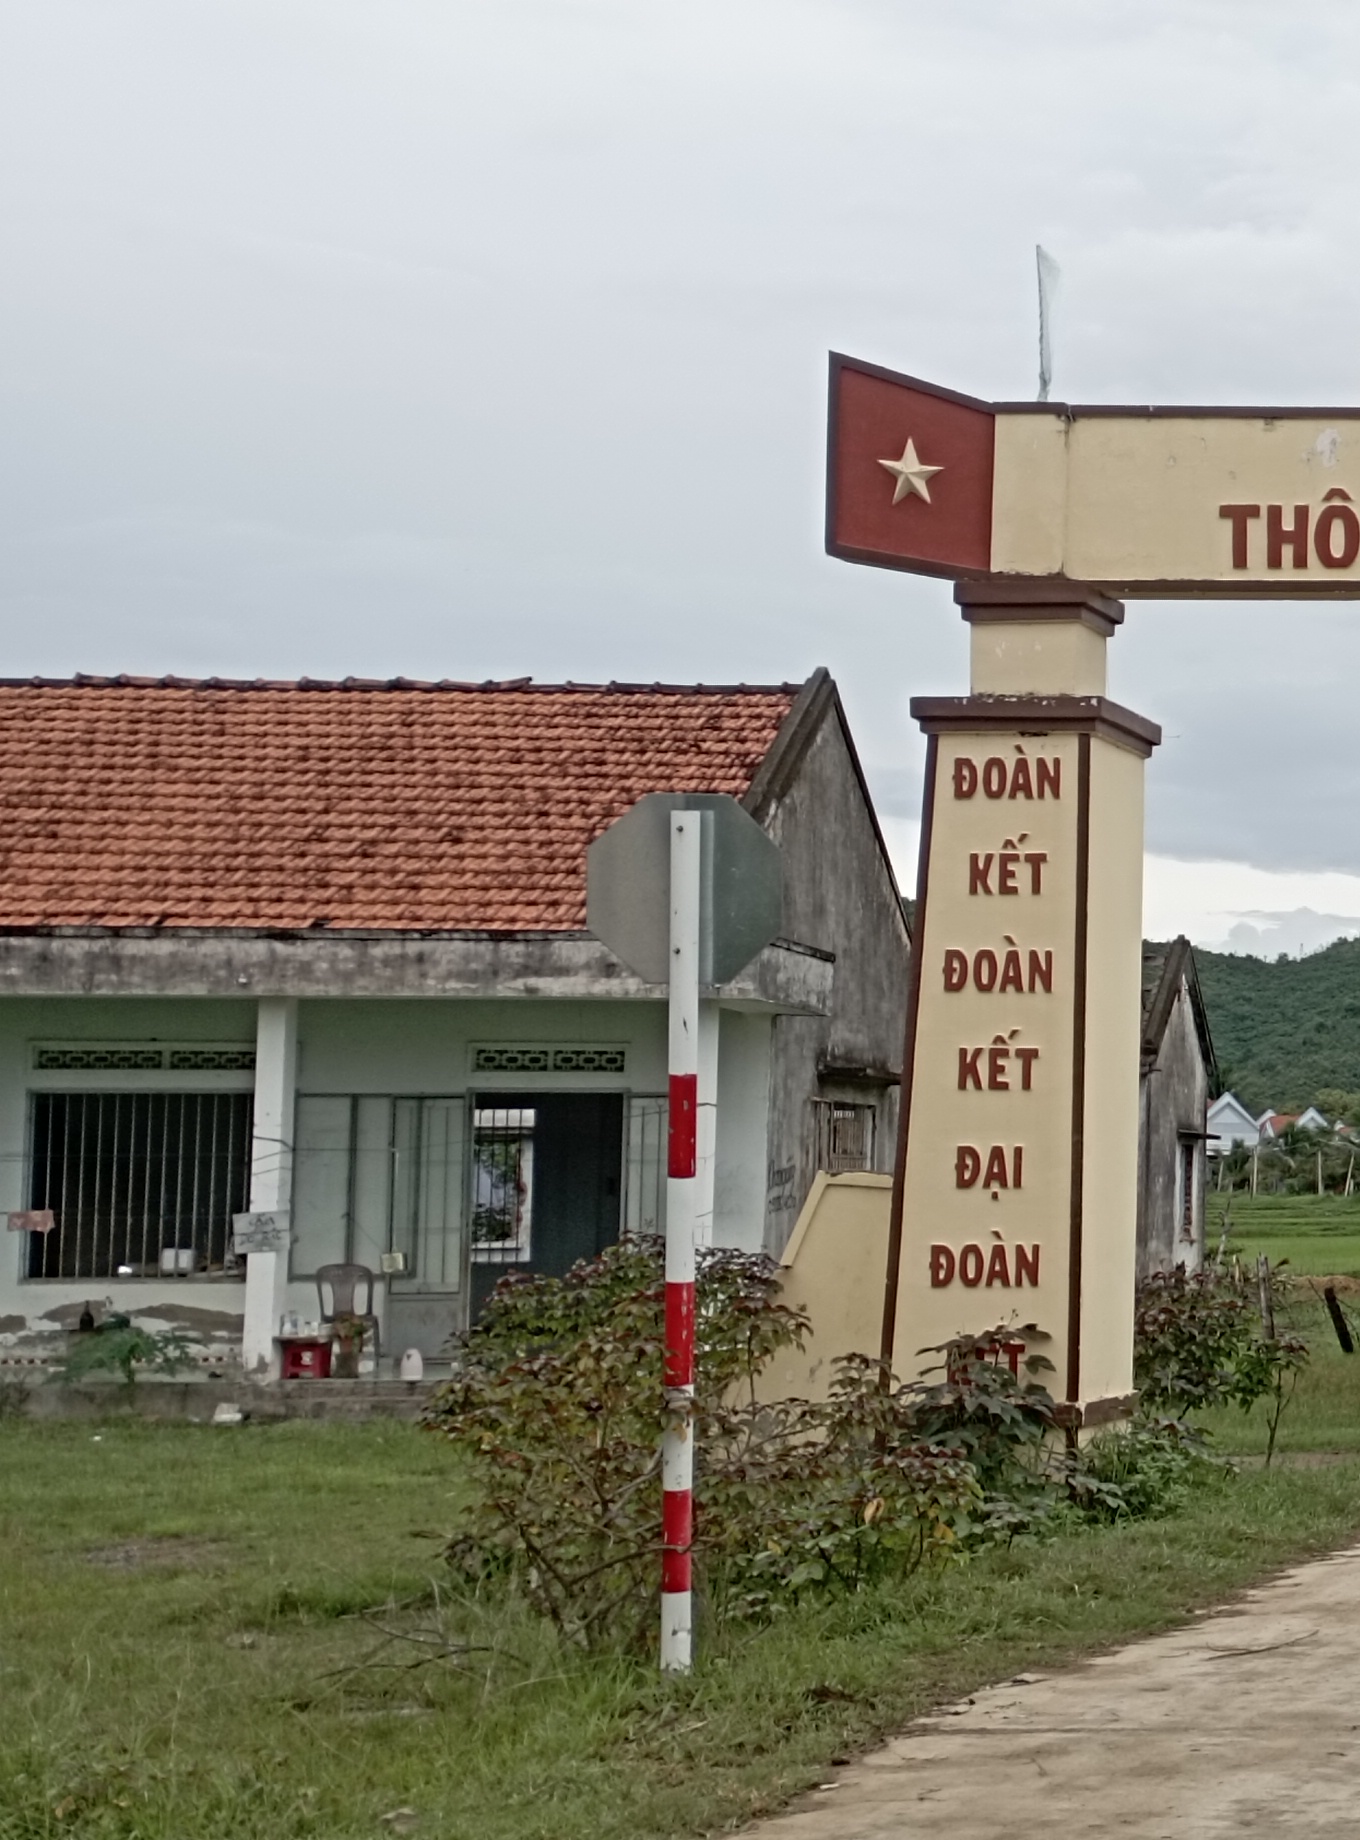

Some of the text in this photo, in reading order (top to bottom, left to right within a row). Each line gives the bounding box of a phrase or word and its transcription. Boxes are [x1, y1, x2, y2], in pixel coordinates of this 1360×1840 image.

[952, 743, 1062, 801] ĐOÀN
[968, 832, 1048, 896] KẾT
[942, 935, 1053, 993] ĐOÀN
[957, 1029, 1040, 1091] KẾT
[955, 1145, 1023, 1201] ĐẠI
[929, 1230, 1041, 1288] ĐOÀN
